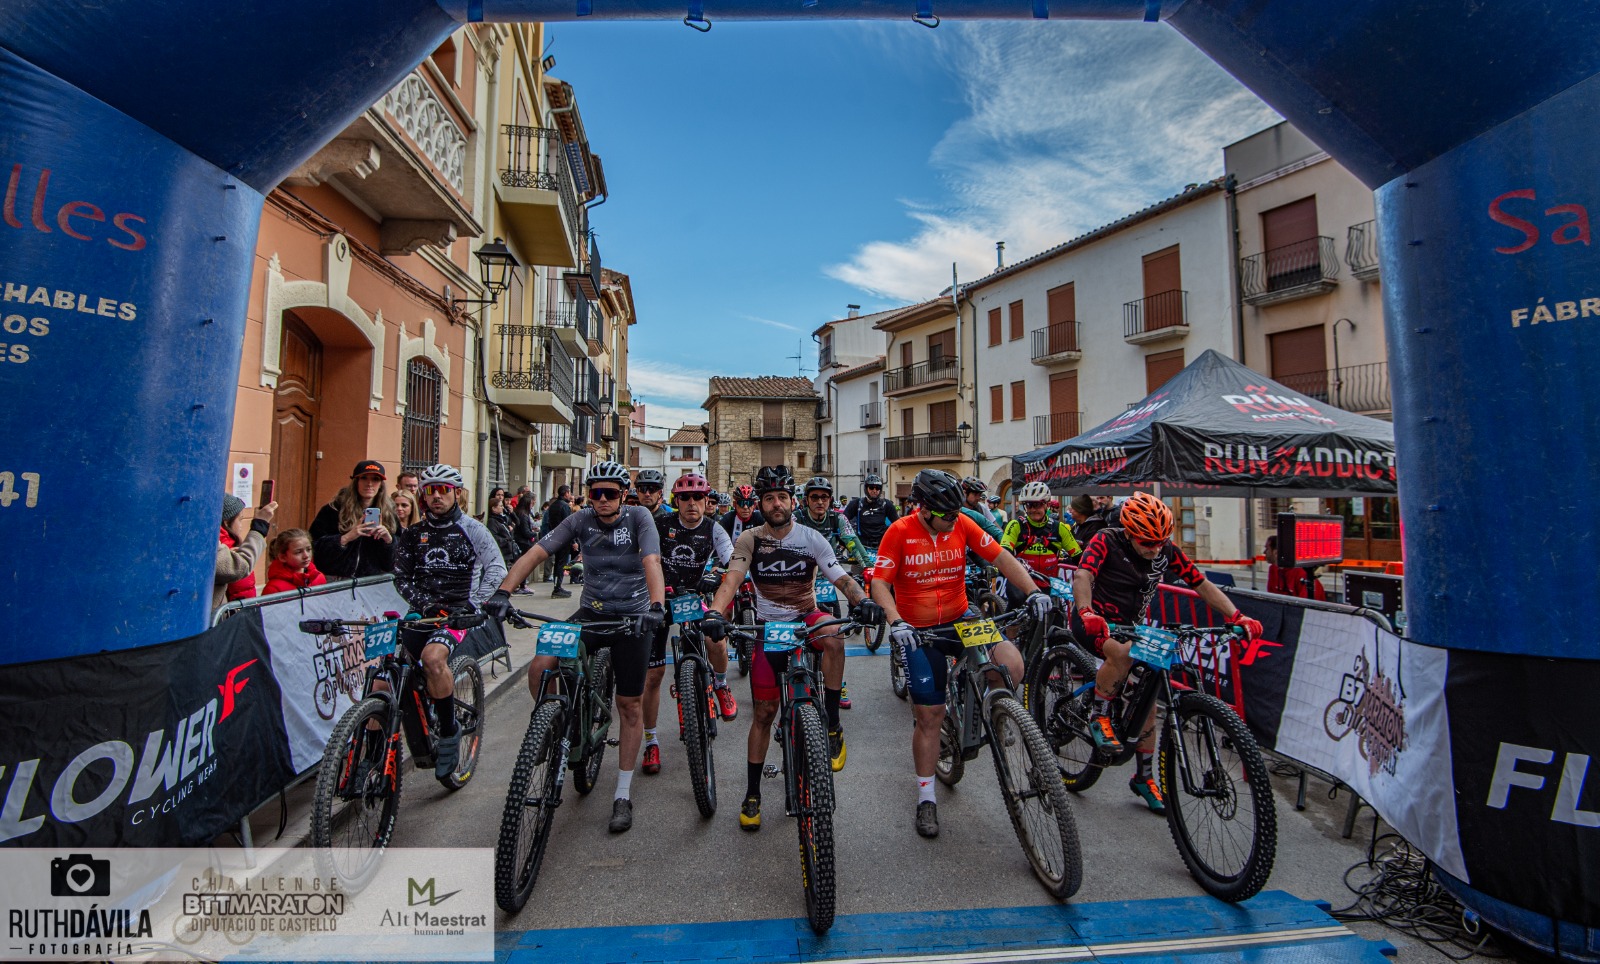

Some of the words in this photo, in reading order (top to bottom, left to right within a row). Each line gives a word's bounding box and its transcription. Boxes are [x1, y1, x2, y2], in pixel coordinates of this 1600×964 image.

[1489, 189, 1591, 254] Sa
[0, 282, 137, 321] HABLES
[1511, 297, 1600, 328] FÁBR
[0, 313, 50, 337] OS
[1053, 446, 1128, 478] ADDICTION
[1204, 442, 1269, 475] RUN
[757, 560, 807, 572] KIA
[905, 547, 964, 566] MONPEDAL
[674, 601, 700, 614] 356
[367, 630, 393, 648] 378
[539, 630, 577, 645] 350
[962, 625, 994, 638] 325
[900, 645, 912, 688] ONPEDAL
[0, 698, 218, 842] LOWER
[131, 783, 194, 825] CYCLING
[198, 762, 218, 786] WEAR
